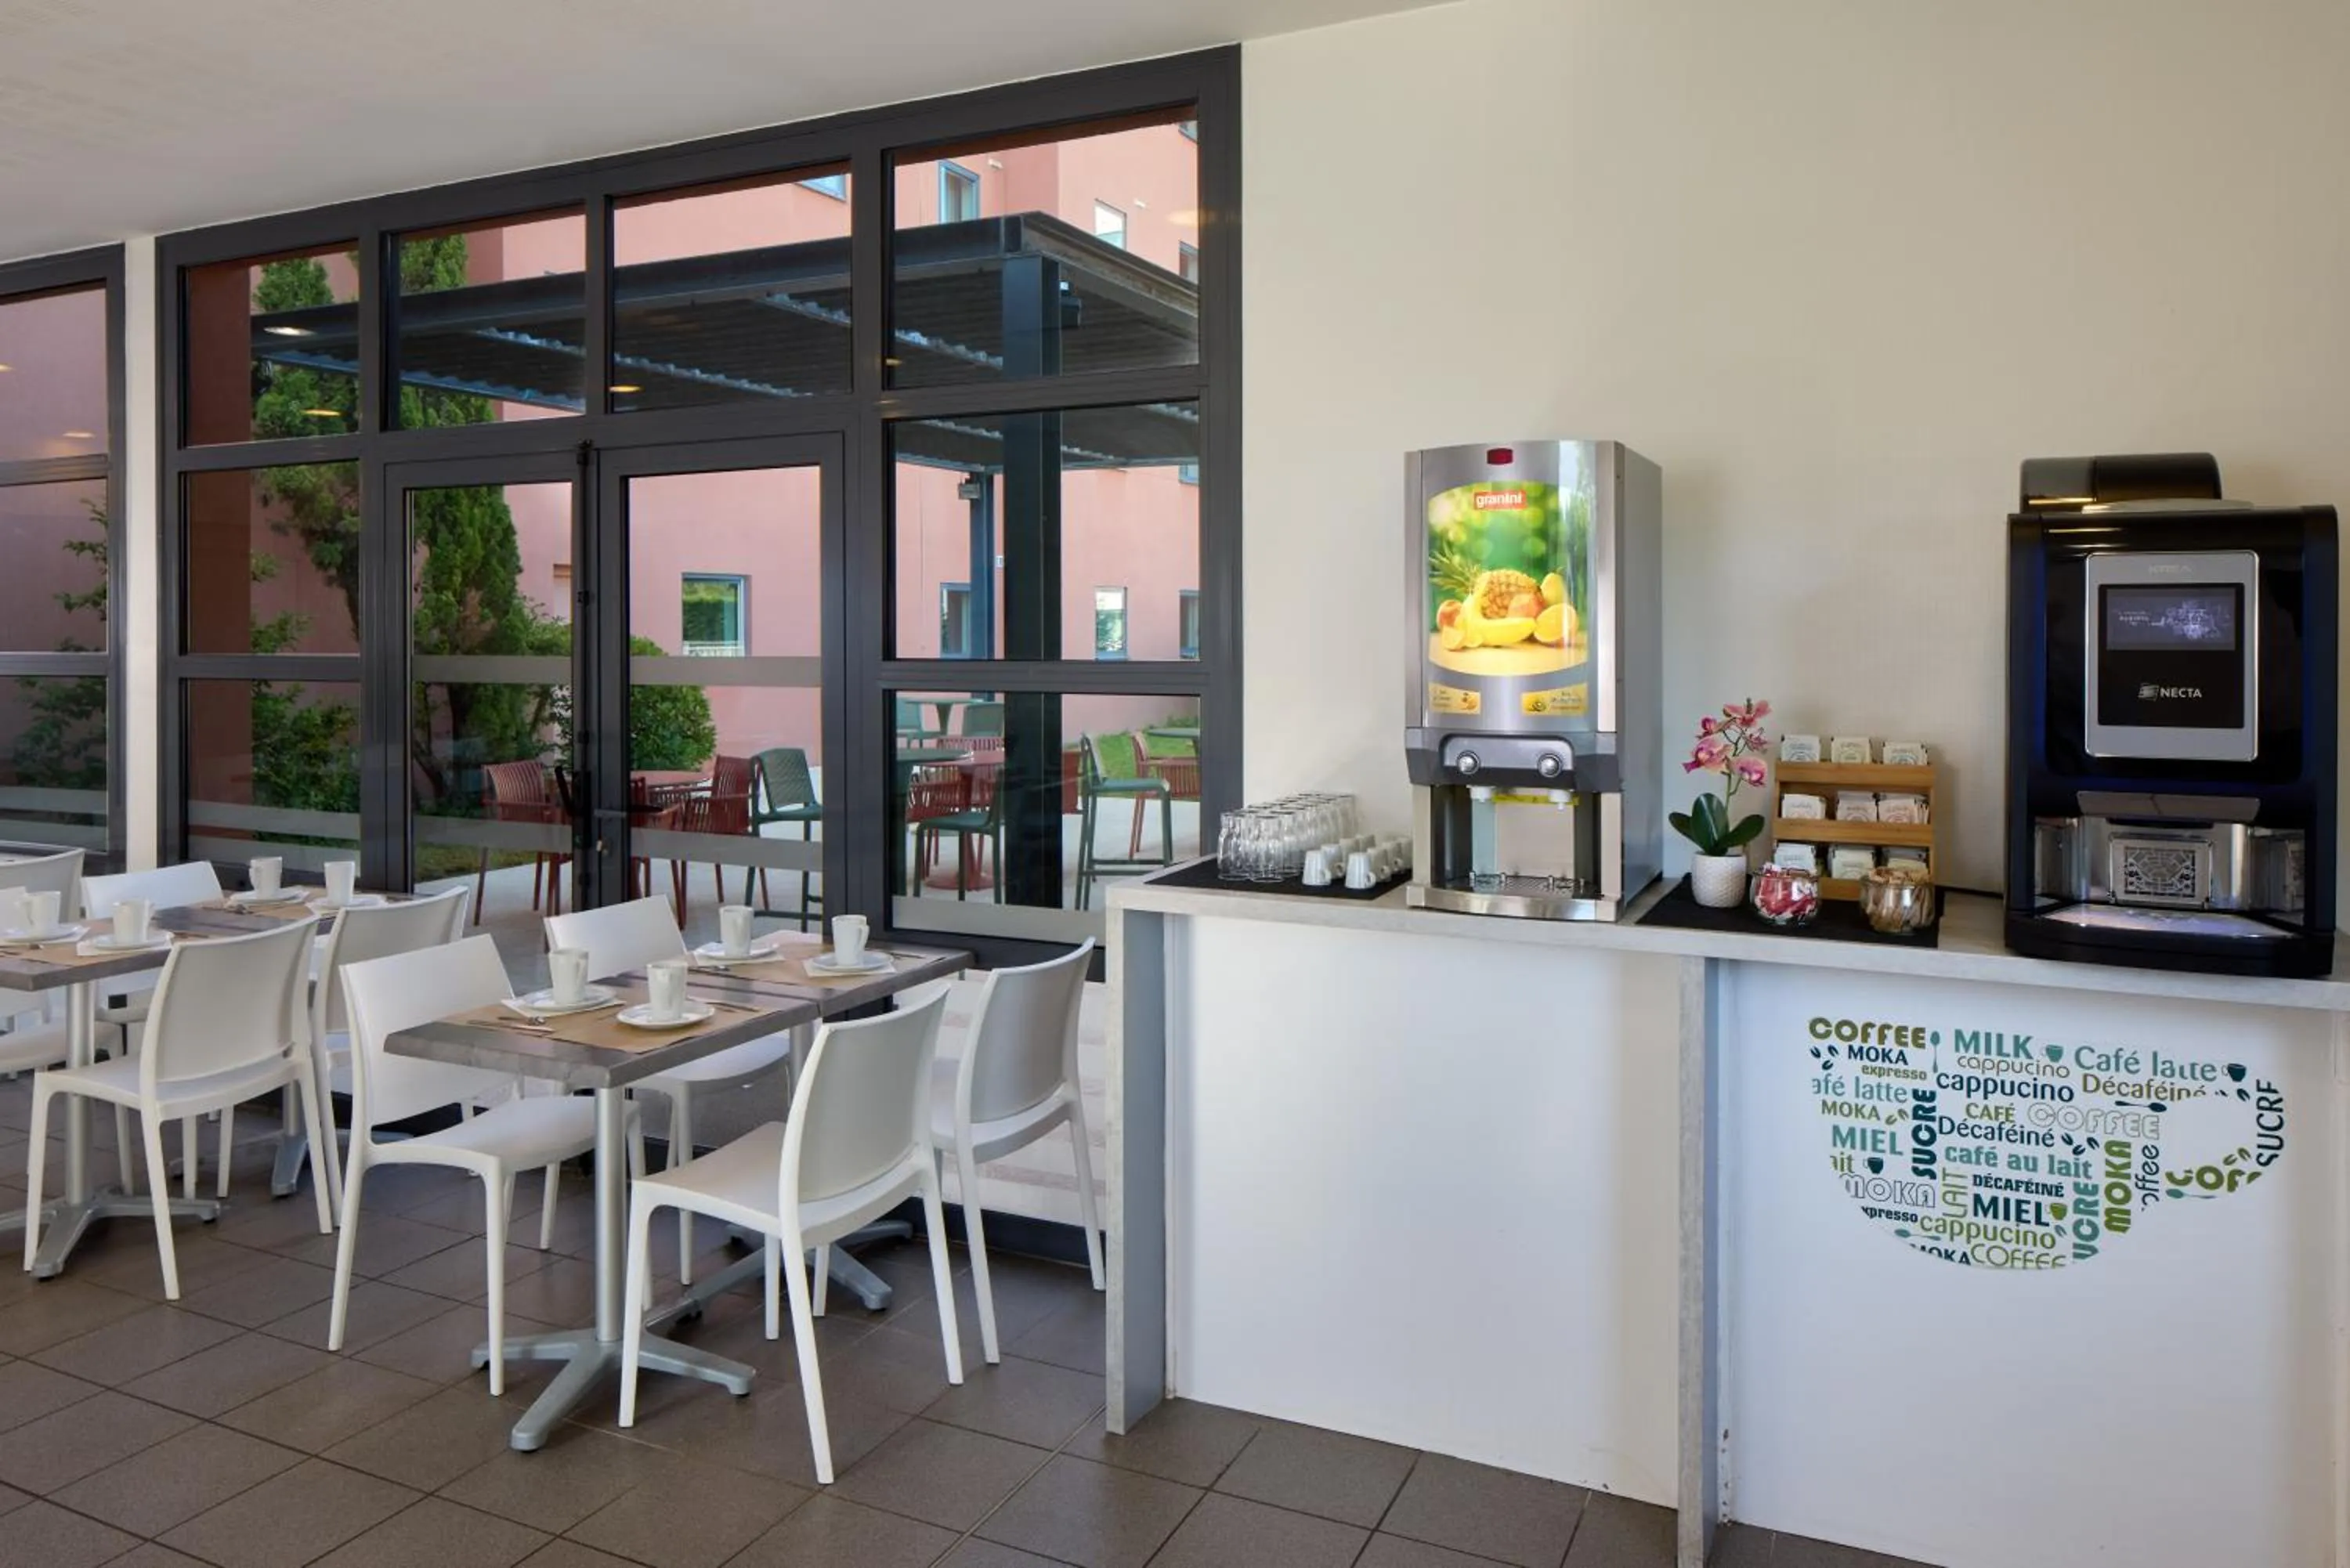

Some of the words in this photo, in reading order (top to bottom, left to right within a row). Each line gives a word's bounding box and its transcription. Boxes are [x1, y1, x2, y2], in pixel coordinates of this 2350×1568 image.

[1477, 492, 1523, 508] granini
[2160, 688, 2203, 699] NECTA
[1808, 1017, 1927, 1050] COFFEE
[1954, 1028, 2034, 1060] MILK
[1847, 1044, 1909, 1066] MOKA
[1956, 1054, 2070, 1078] cappucino
[2073, 1045, 2141, 1075] Café
[2152, 1050, 2218, 1082] latte
[1860, 1064, 1928, 1082] expresso
[1936, 1071, 2074, 1103] cappucino
[1854, 1075, 1908, 1104] latte
[1821, 1098, 1881, 1122] MOKA
[1965, 1102, 2016, 1122] CAFÉ
[2026, 1101, 2160, 1141] COFFEE
[1831, 1124, 1904, 1156] MIEL
[1911, 1088, 1937, 1180] SUCRE
[1939, 1115, 2055, 1148] Décaféiné
[1944, 1145, 1998, 1169] café
[2007, 1153, 2038, 1172] au
[2047, 1154, 2092, 1180] lait
[1942, 1167, 1969, 1219] LAIT
[1972, 1173, 2065, 1198] DÉCAFÉINÉ
[2103, 1140, 2132, 1234] MOKA
[1972, 1193, 2050, 1227] MIEL
[1920, 1216, 2056, 1249] cappucino
